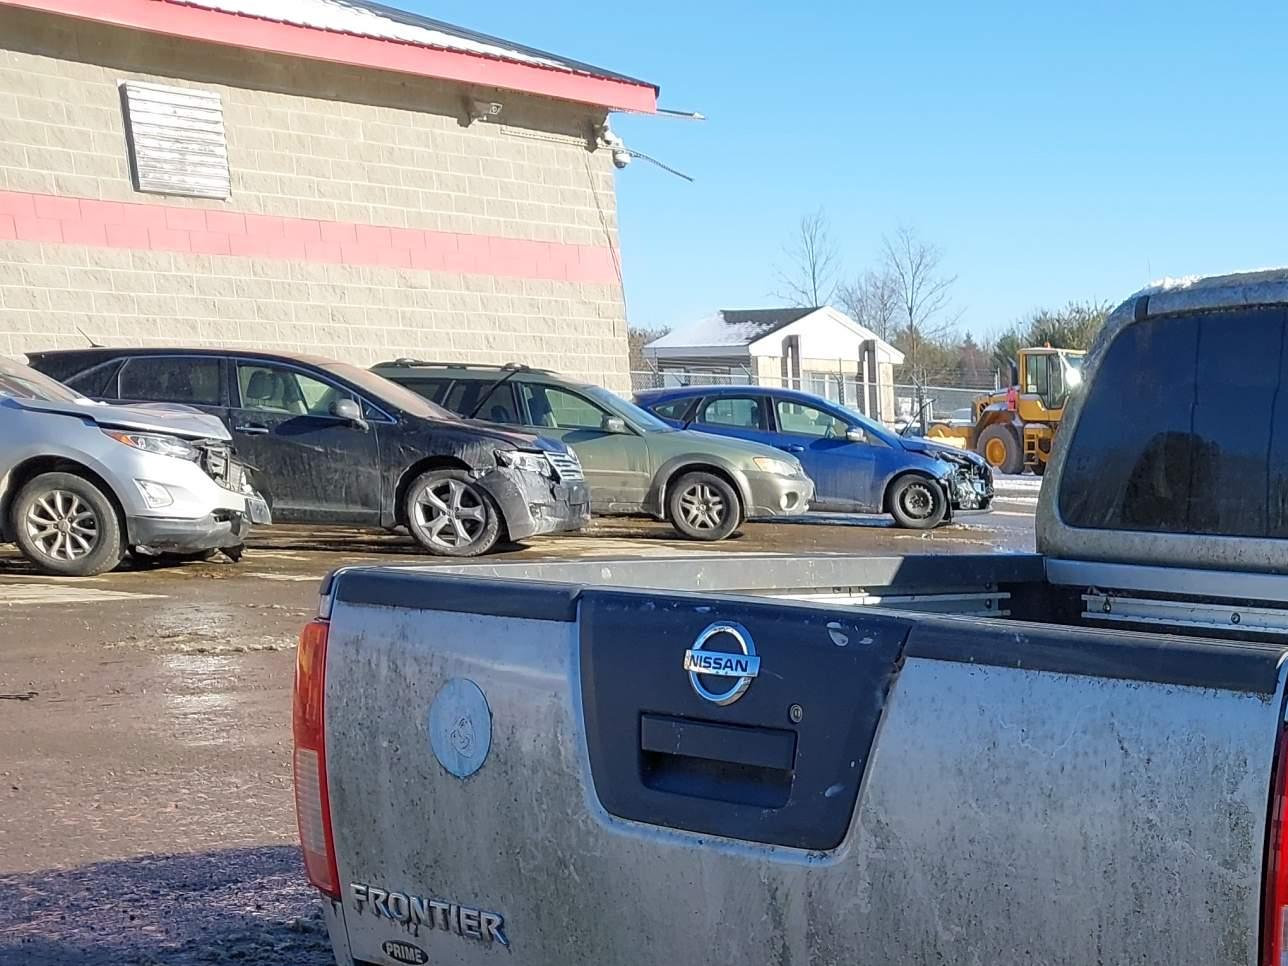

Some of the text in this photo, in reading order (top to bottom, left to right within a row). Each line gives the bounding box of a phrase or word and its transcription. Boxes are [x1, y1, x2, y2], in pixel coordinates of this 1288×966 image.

[689, 654, 749, 673] NISSAN
[350, 883, 510, 947] FRONTIER
[385, 942, 424, 964] PRIME
